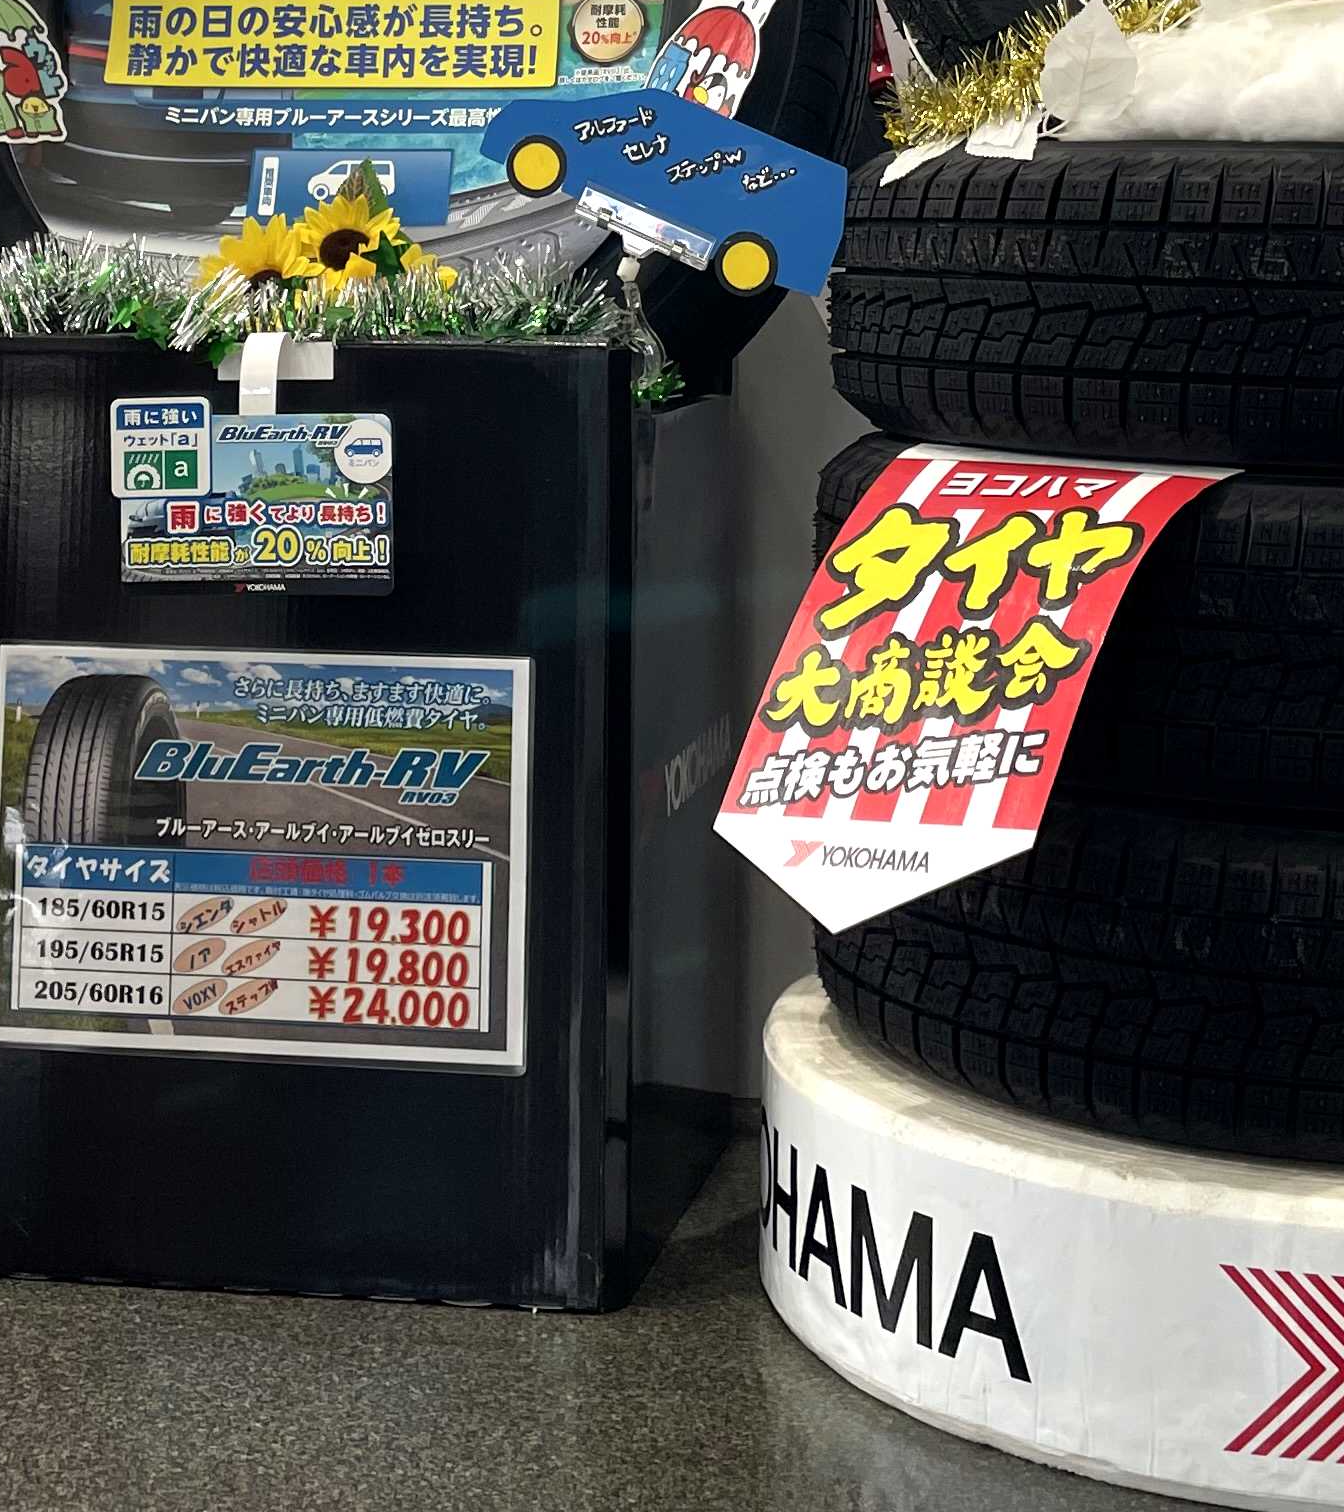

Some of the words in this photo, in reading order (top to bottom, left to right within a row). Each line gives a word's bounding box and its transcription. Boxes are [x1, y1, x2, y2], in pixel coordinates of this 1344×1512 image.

[128, 3, 545, 41] 雨の日の安心感が長持ち。
[596, 17, 620, 29] 性能
[573, 106, 654, 142] アルファード
[622, 134, 670, 163] セレナ
[123, 408, 197, 426] 雨に強い
[218, 425, 349, 442] BluEarth-RV
[173, 459, 189, 478] a
[939, 472, 1119, 499] ヨコハマ
[820, 507, 1134, 631] タイヤ
[245, 583, 286, 592] YOKOHAMA
[765, 621, 1081, 729] 大商談会
[233, 676, 492, 705] さらに長持ち、ますます快適に。
[255, 701, 488, 730] ミニバン専用低燃費タイヤ。
[135, 739, 491, 790] BluEarth-RV
[739, 732, 1048, 806] 点検もお気軽に
[398, 789, 458, 806] RV03
[26, 854, 171, 883] タイヤサイズ
[821, 845, 930, 873] YOKOHAMA
[36, 896, 166, 921] 185/60R15
[232, 900, 287, 934] シャトル
[35, 938, 165, 964] 195/65R15
[189, 947, 212, 970] ノア
[34, 980, 164, 1006] 205/60R16
[182, 983, 218, 1010] VOXY
[759, 1130, 1033, 1385] HAMA
